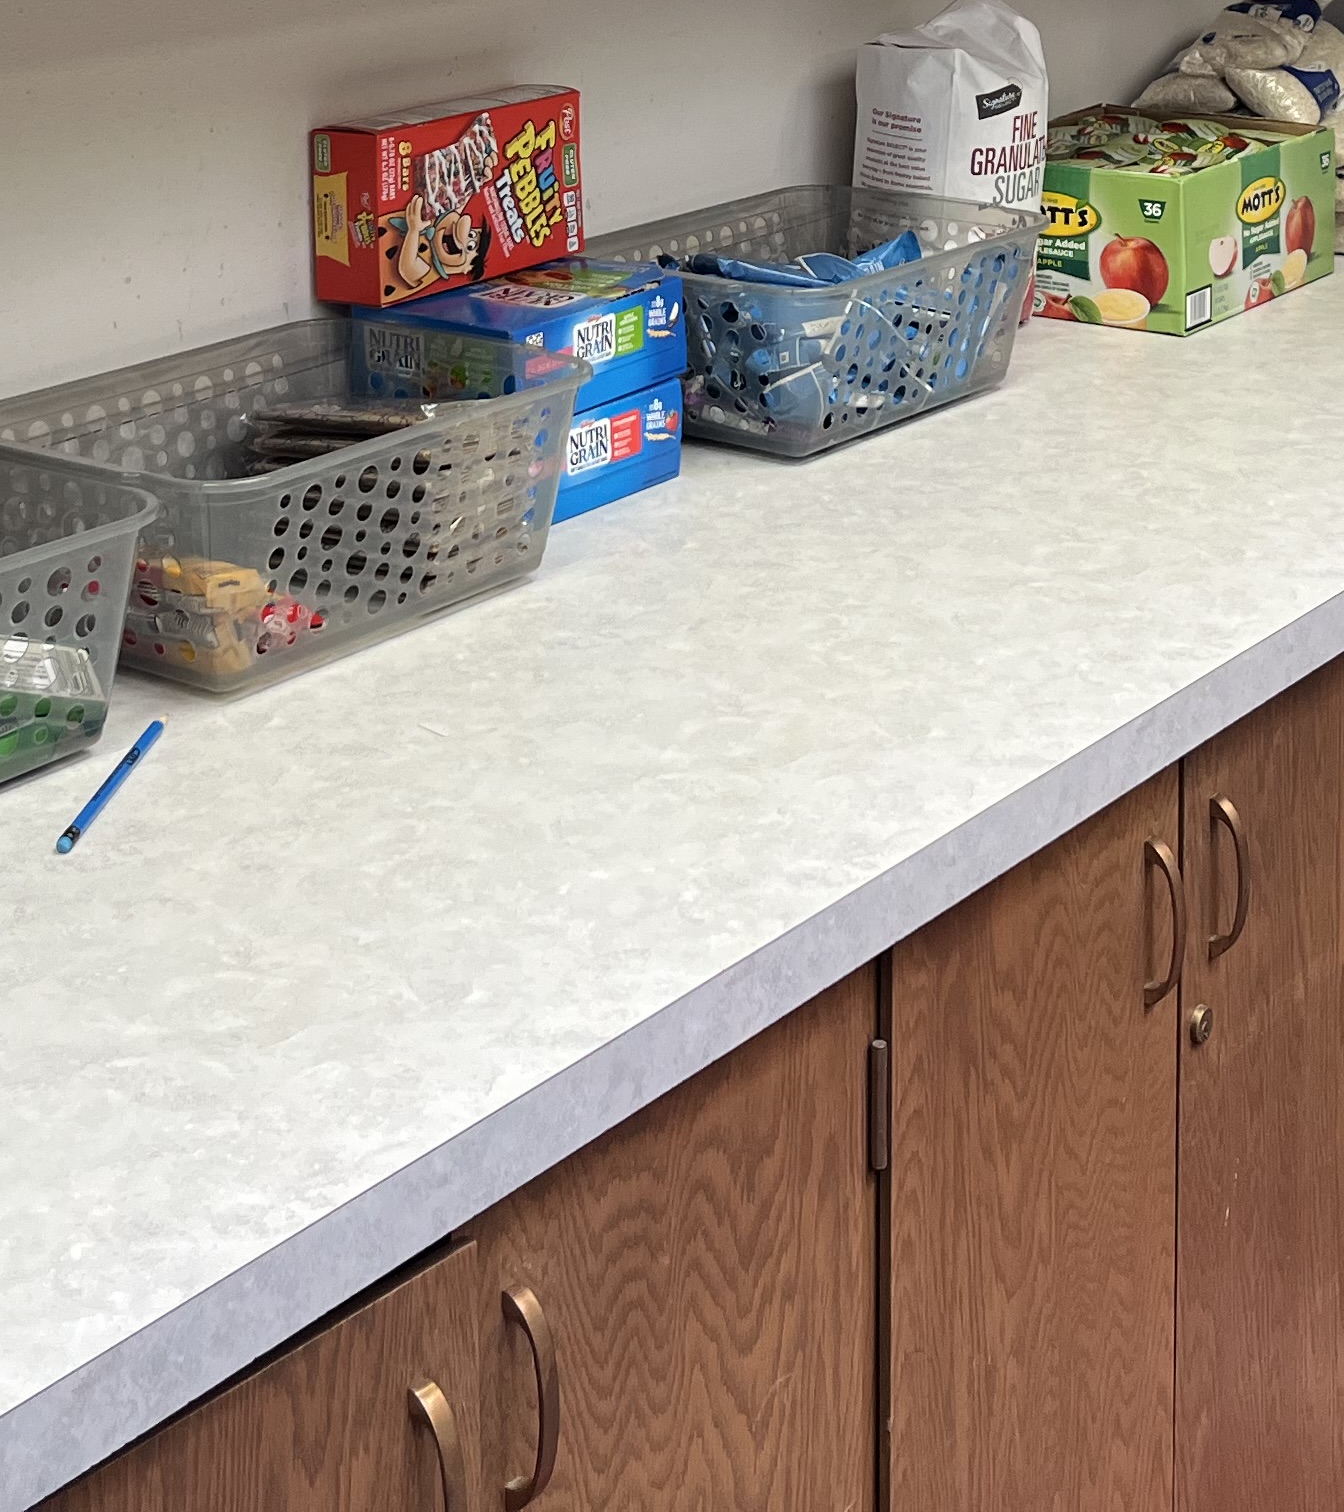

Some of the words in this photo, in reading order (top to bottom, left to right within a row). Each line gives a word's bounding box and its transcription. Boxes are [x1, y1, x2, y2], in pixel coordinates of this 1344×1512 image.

[1012, 111, 1038, 144] FINE
[399, 141, 413, 156] 8
[402, 158, 412, 191] Bars
[505, 119, 553, 247] PEBBLES
[535, 120, 564, 229] FRUITY
[993, 167, 1041, 205] SUGAR
[495, 168, 525, 243] Treats
[1144, 202, 1162, 217] 36
[1242, 185, 1281, 215] MOTT'S
[1054, 239, 1086, 251] Added
[369, 329, 421, 355] NUTRI
[577, 319, 613, 345] NUTRI
[577, 337, 614, 361] GRAIN
[570, 426, 608, 451] NUTRI
[570, 442, 611, 467] GRAIN
